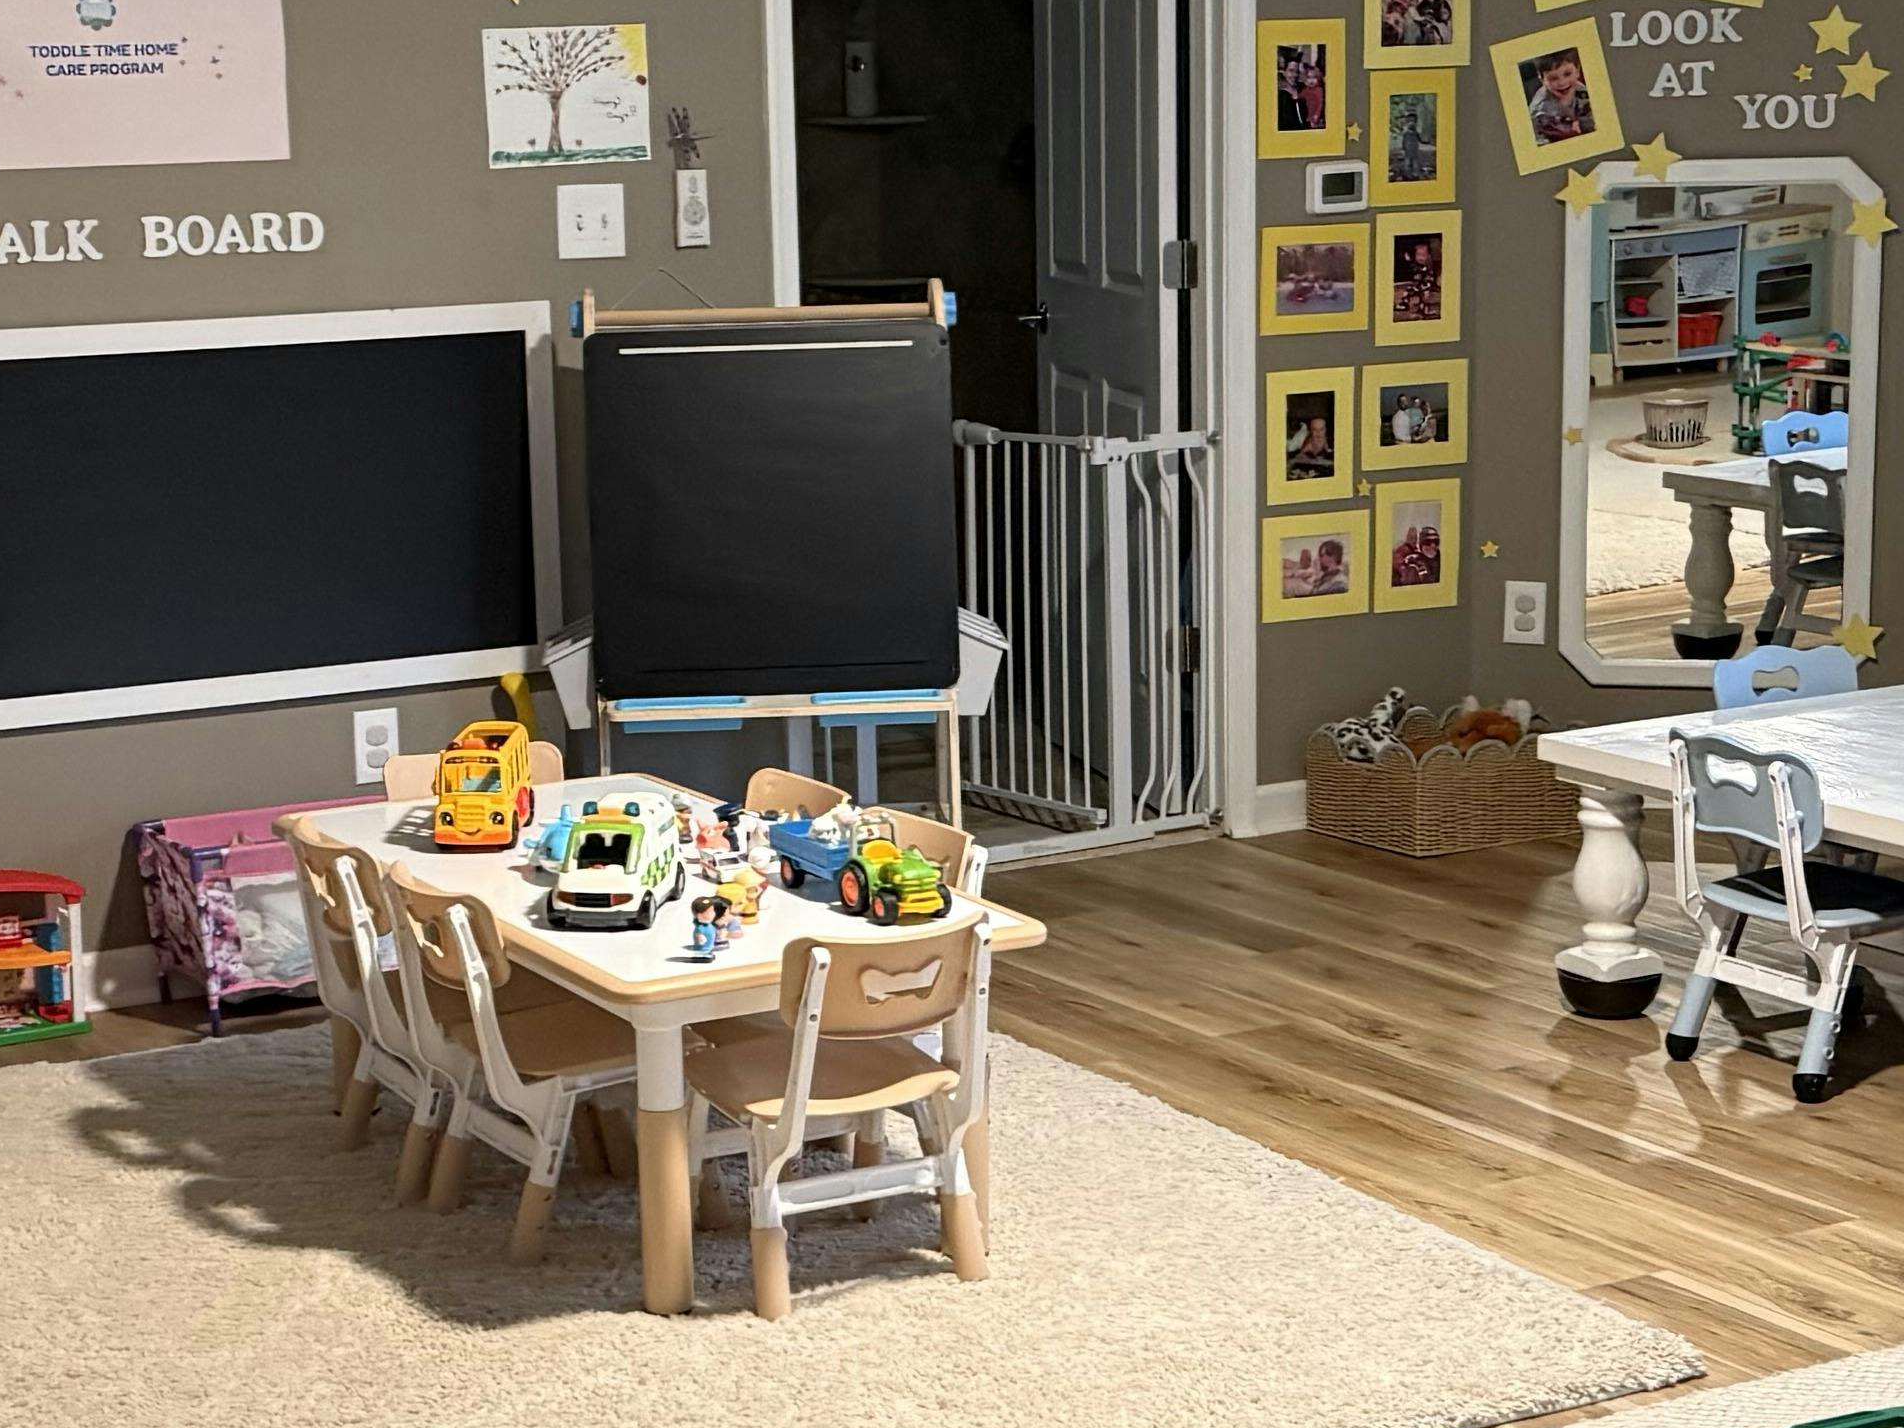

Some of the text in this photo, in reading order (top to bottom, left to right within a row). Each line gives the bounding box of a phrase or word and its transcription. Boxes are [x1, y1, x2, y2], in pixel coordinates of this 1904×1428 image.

[1608, 6, 1743, 47] LOOK
[29, 43, 179, 58] TODDLE TIME HOME
[45, 62, 164, 77] CARE PROGRAM
[1648, 60, 1715, 98] AT
[1733, 92, 1838, 130] YOU
[140, 210, 325, 258] BOARD
